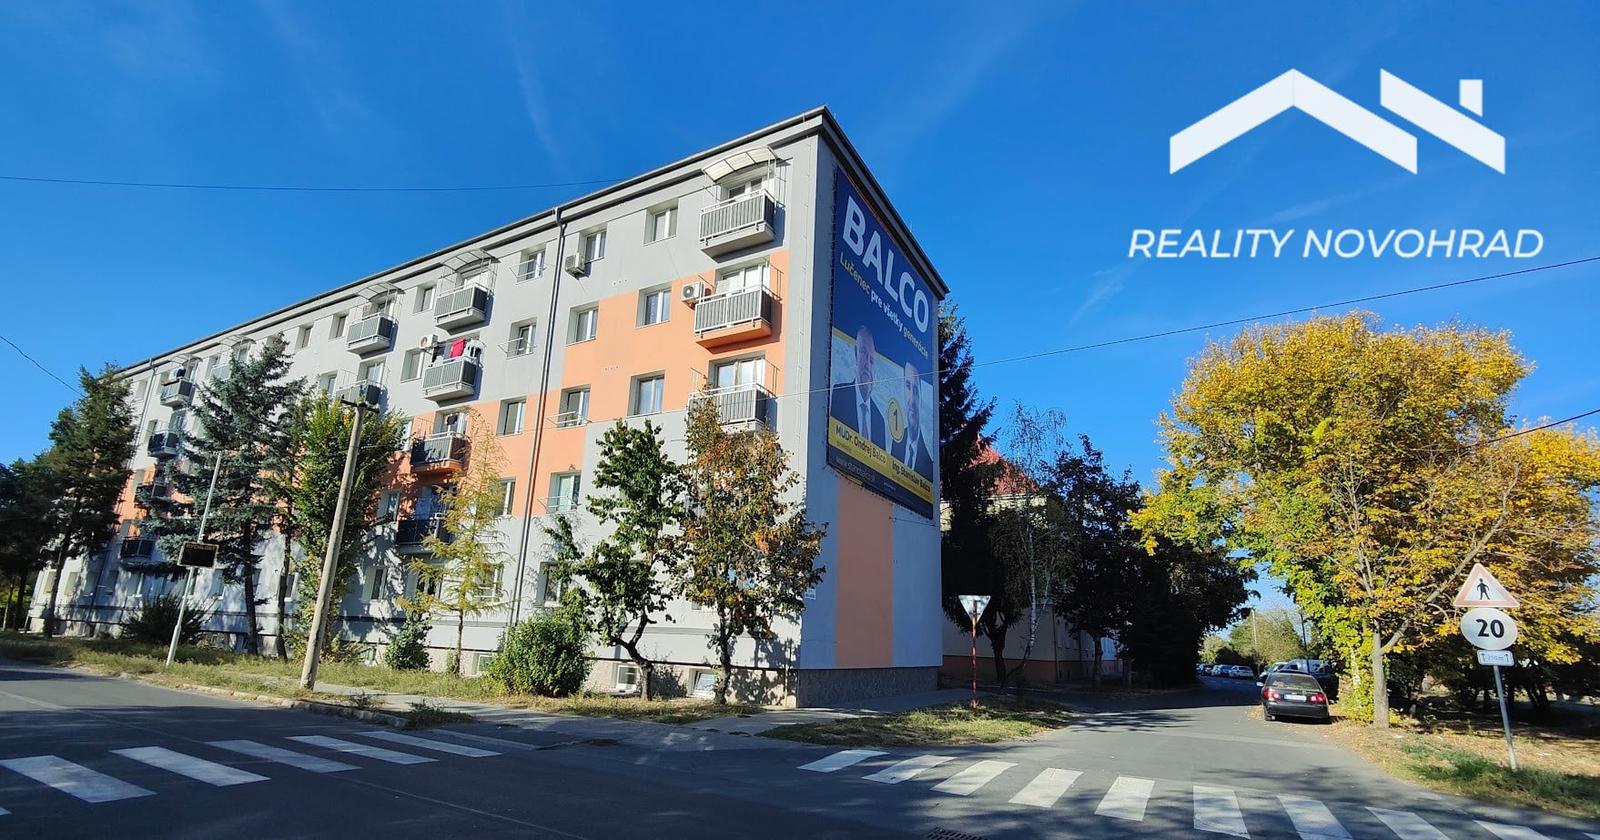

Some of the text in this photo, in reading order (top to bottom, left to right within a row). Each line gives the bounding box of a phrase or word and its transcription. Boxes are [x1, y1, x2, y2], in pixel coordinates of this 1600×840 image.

[843, 195, 929, 333] BALCO
[839, 252, 870, 294] Lučenec
[871, 289, 883, 309] pre
[882, 302, 904, 333] všetky
[893, 410, 899, 432] 1
[836, 424, 854, 444] MUDr.
[854, 436, 872, 458] Ondrej
[873, 447, 886, 464] Balco
[1476, 619, 1505, 638] 20
